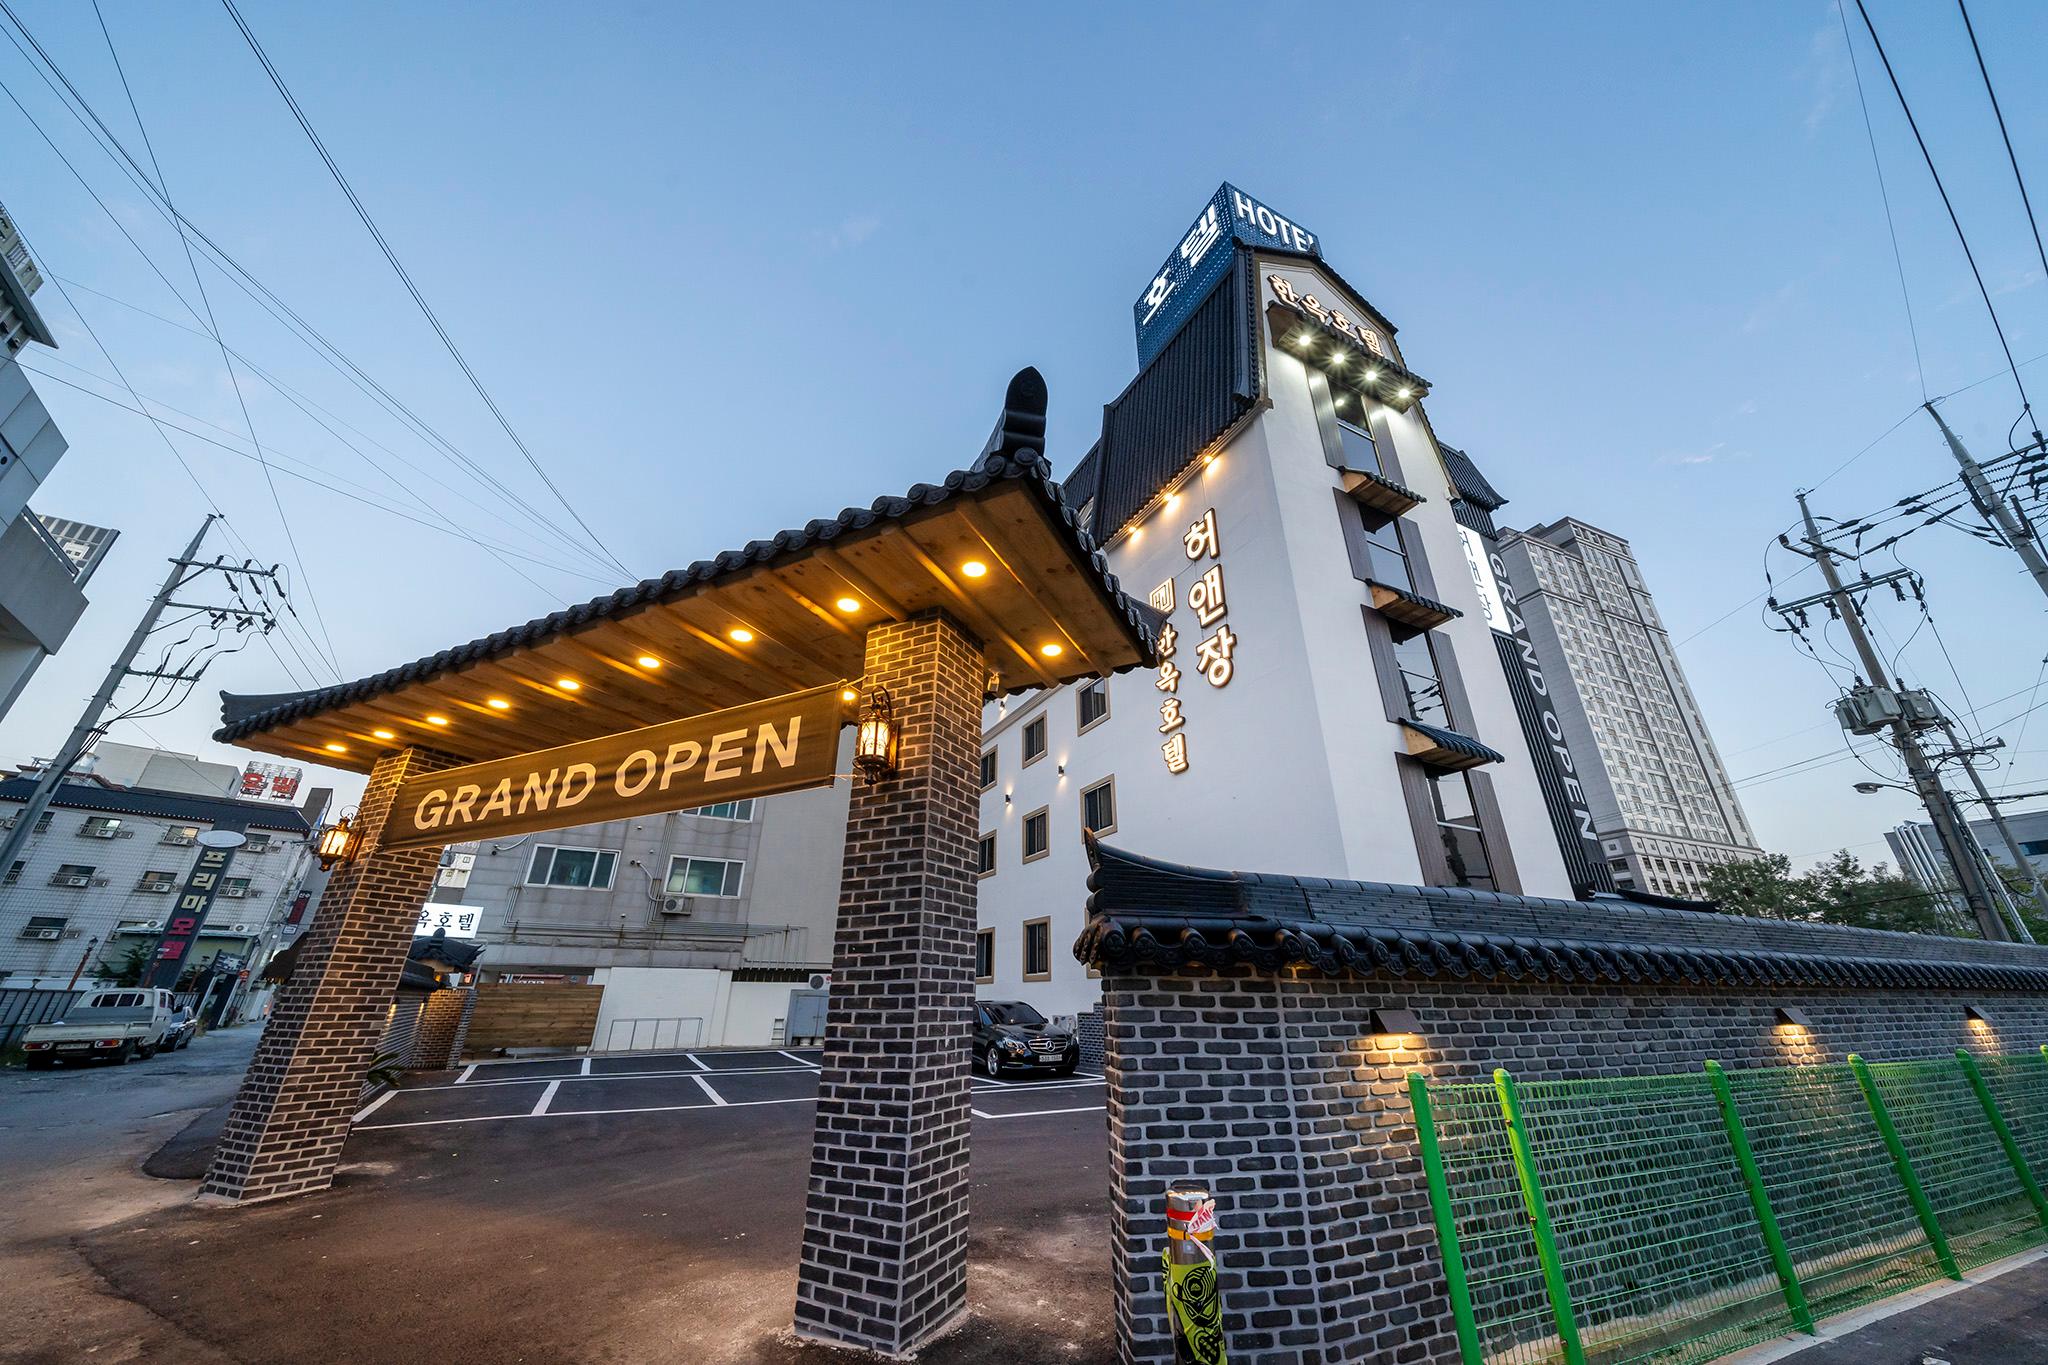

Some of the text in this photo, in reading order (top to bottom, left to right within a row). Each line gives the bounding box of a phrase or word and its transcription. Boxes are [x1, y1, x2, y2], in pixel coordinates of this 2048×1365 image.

[1143, 204, 1222, 326] 호텔
[1183, 507, 1238, 689] 허앤장
[1489, 552, 1598, 841] GRAND OPEN
[413, 715, 802, 831] GRAND OPEN
